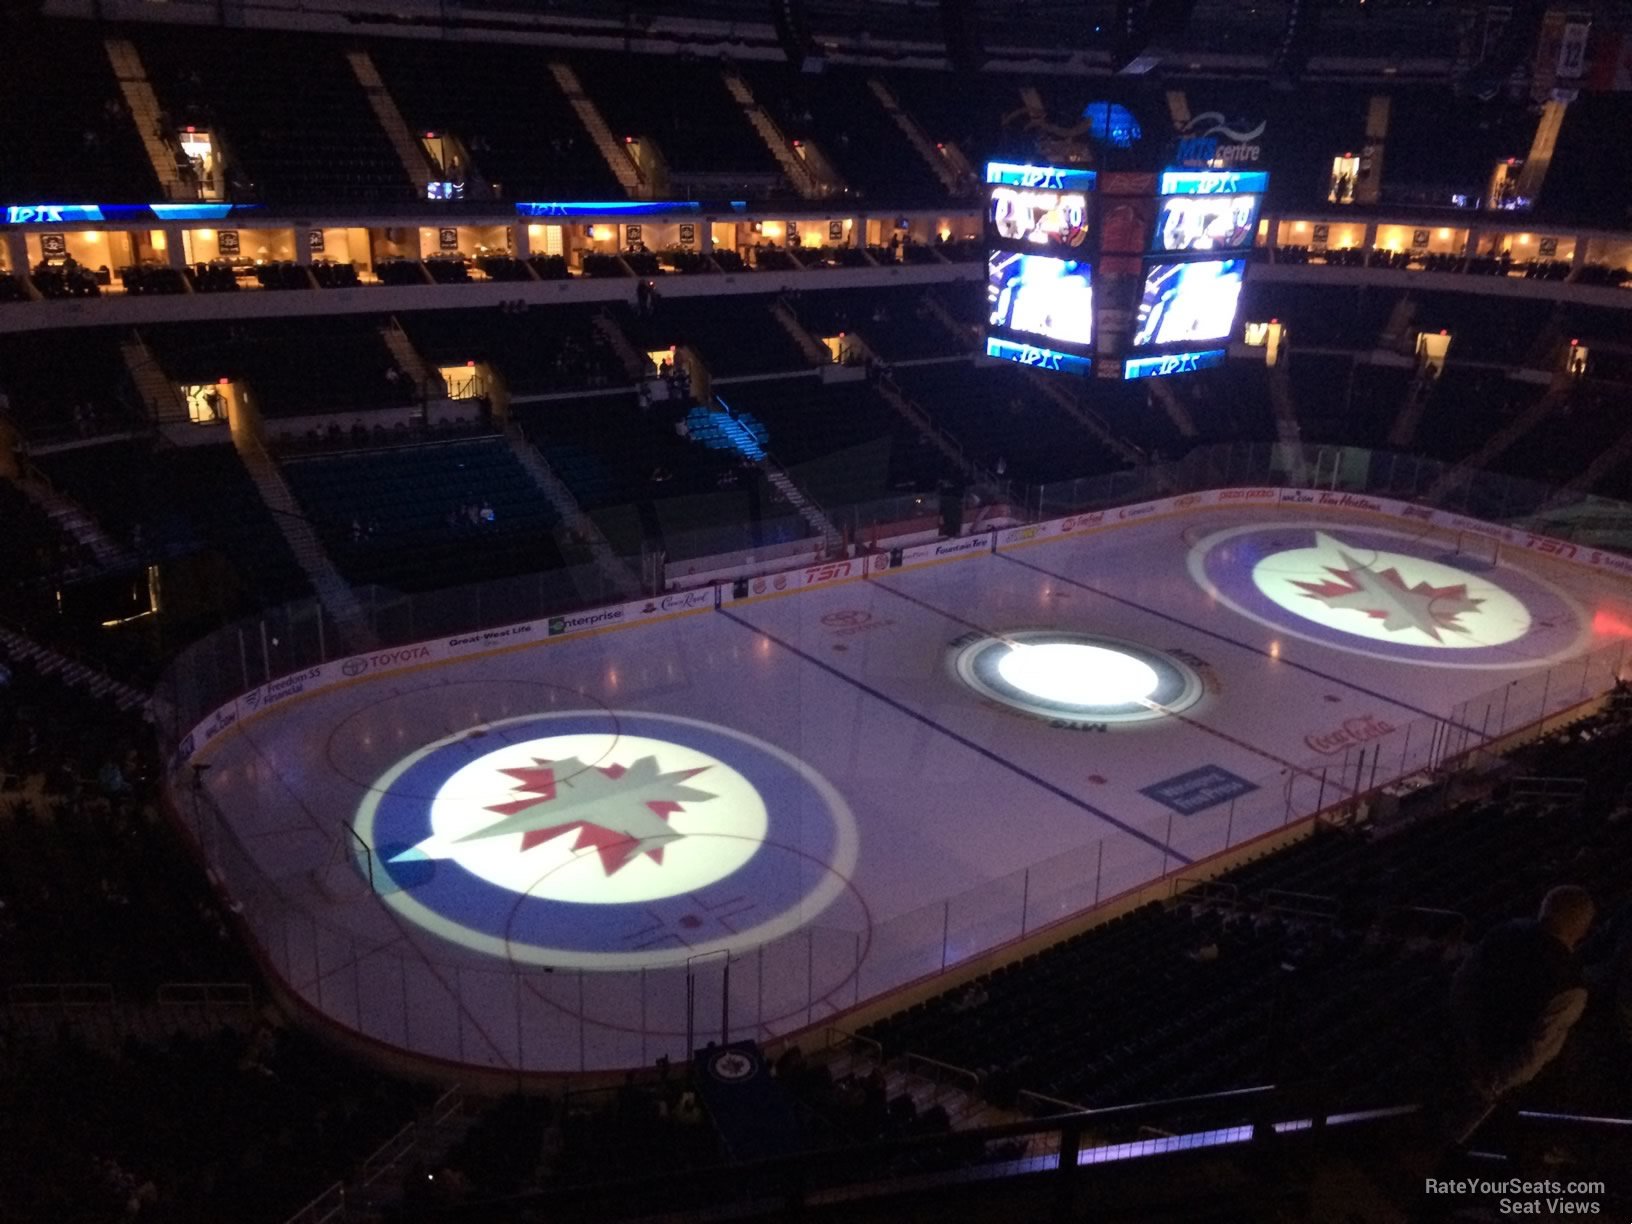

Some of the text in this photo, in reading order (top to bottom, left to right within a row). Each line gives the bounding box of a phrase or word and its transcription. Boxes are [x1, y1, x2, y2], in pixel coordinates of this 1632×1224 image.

[1216, 142, 1260, 161] centre
[804, 562, 852, 584] TSN
[369, 646, 431, 669] TOYOTA
